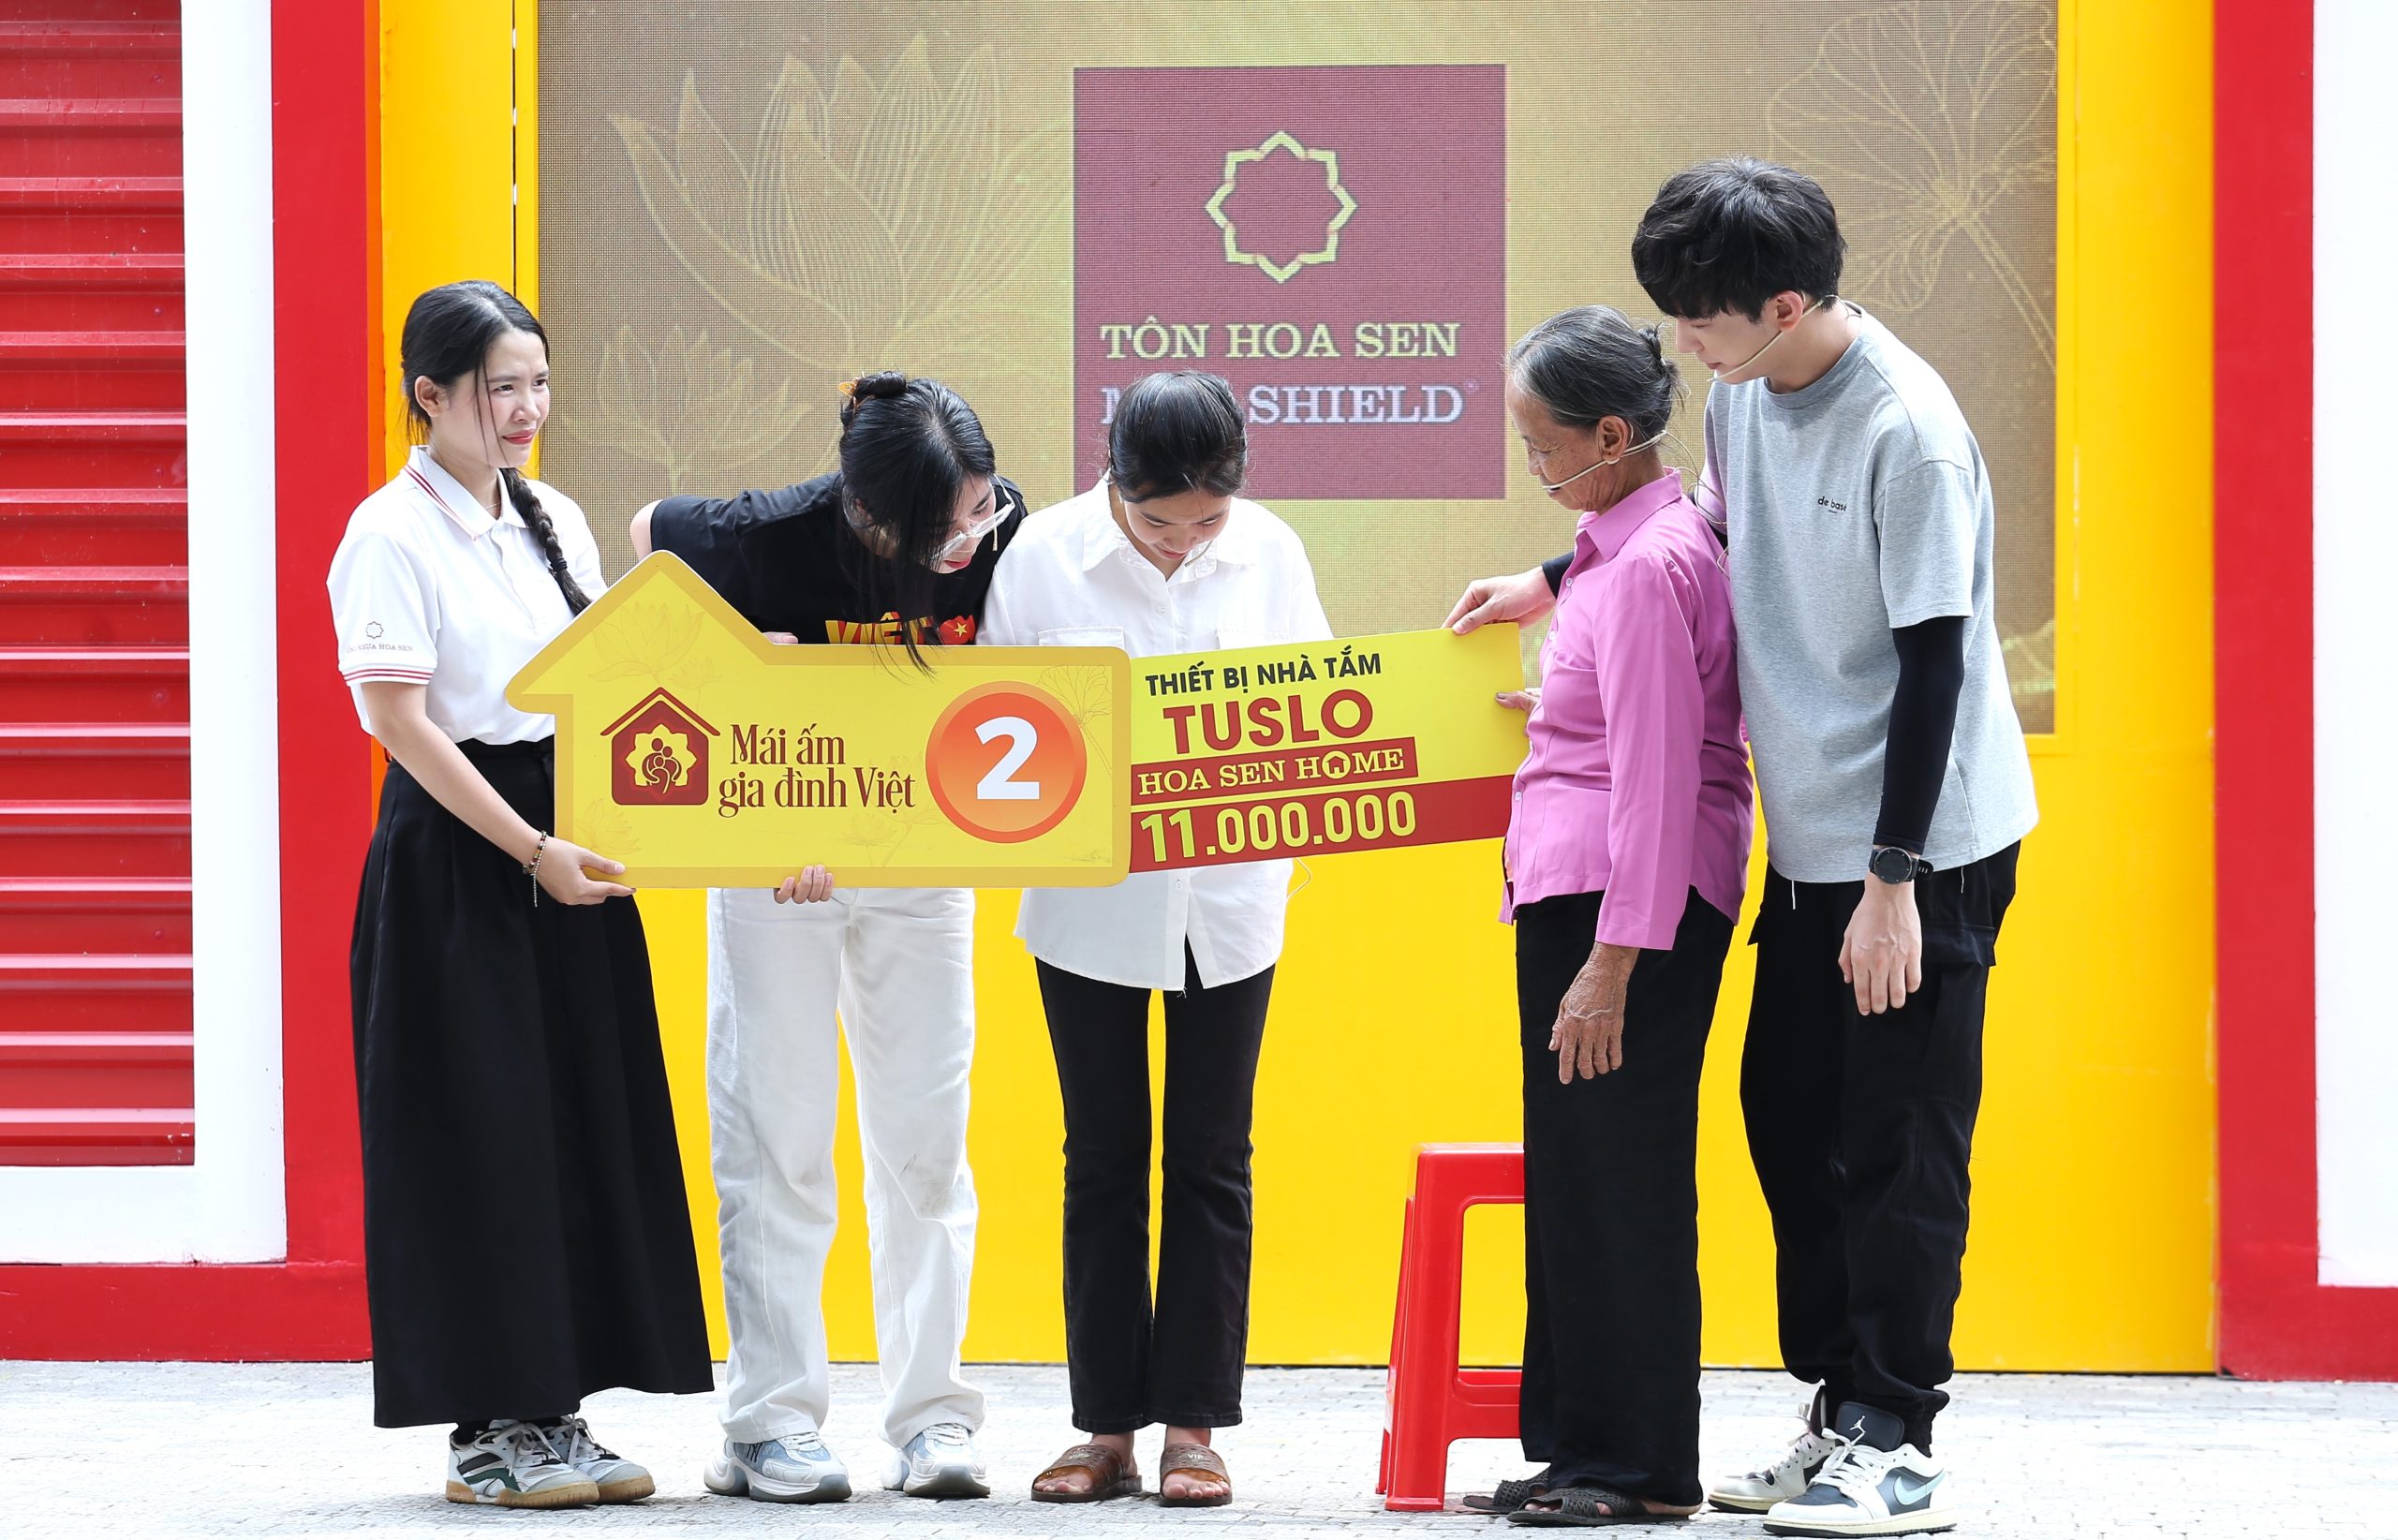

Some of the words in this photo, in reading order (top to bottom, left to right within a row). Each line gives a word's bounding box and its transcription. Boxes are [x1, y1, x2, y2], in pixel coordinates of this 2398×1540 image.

[1100, 317, 1210, 360] TÔN
[1224, 322, 1340, 359] HOA
[1354, 321, 1461, 359] SEN
[1817, 496, 1829, 507] de
[1145, 660, 1215, 696] THIẾT
[1223, 665, 1249, 693] BỊ
[1257, 654, 1317, 686] NHÀ
[1323, 644, 1382, 679] TẮM
[731, 723, 787, 765] Mái
[796, 722, 845, 765] ấm
[1162, 689, 1373, 755] TUSLO
[975, 716, 1041, 801] 2
[1137, 768, 1212, 796] HOA
[1219, 760, 1286, 788] SEN
[719, 770, 764, 818] gia
[775, 766, 848, 807] đình
[853, 767, 915, 815] Việt
[1140, 791, 1416, 863] 11.000.000
